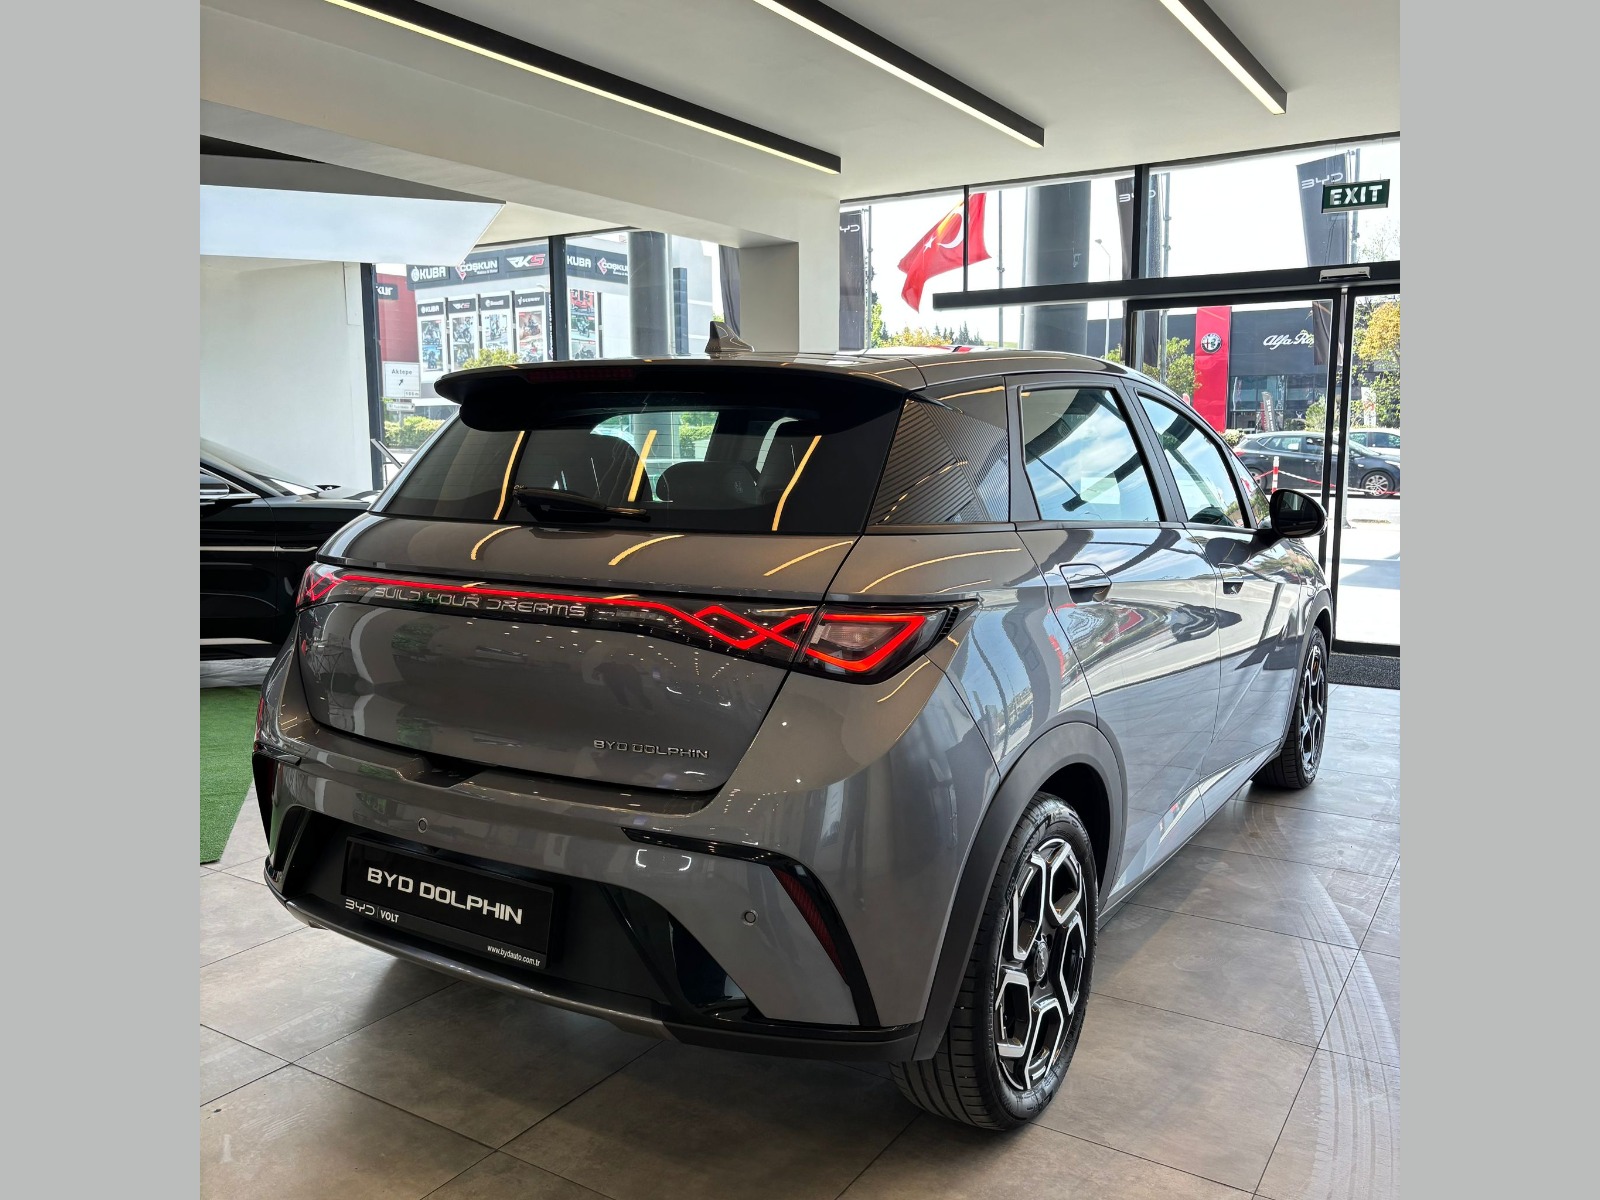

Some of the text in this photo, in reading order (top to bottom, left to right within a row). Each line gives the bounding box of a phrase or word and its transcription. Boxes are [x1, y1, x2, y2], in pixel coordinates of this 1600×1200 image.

[1301, 173, 1343, 189] BYD
[1329, 184, 1383, 206] EXIT
[840, 224, 860, 232] YD
[566, 255, 592, 269] KUBA
[602, 262, 628, 273] COŞKU
[419, 266, 447, 280] KUBA
[1262, 334, 1293, 351] Alfa
[374, 587, 587, 617] BUILD YOUR DREAMS
[593, 739, 709, 759] BYD DOLPHIN
[367, 866, 523, 925] BYD DOLPHIN
[345, 898, 399, 923] BYD VOLT
[487, 944, 541, 967] www.bydauto.com.tr
